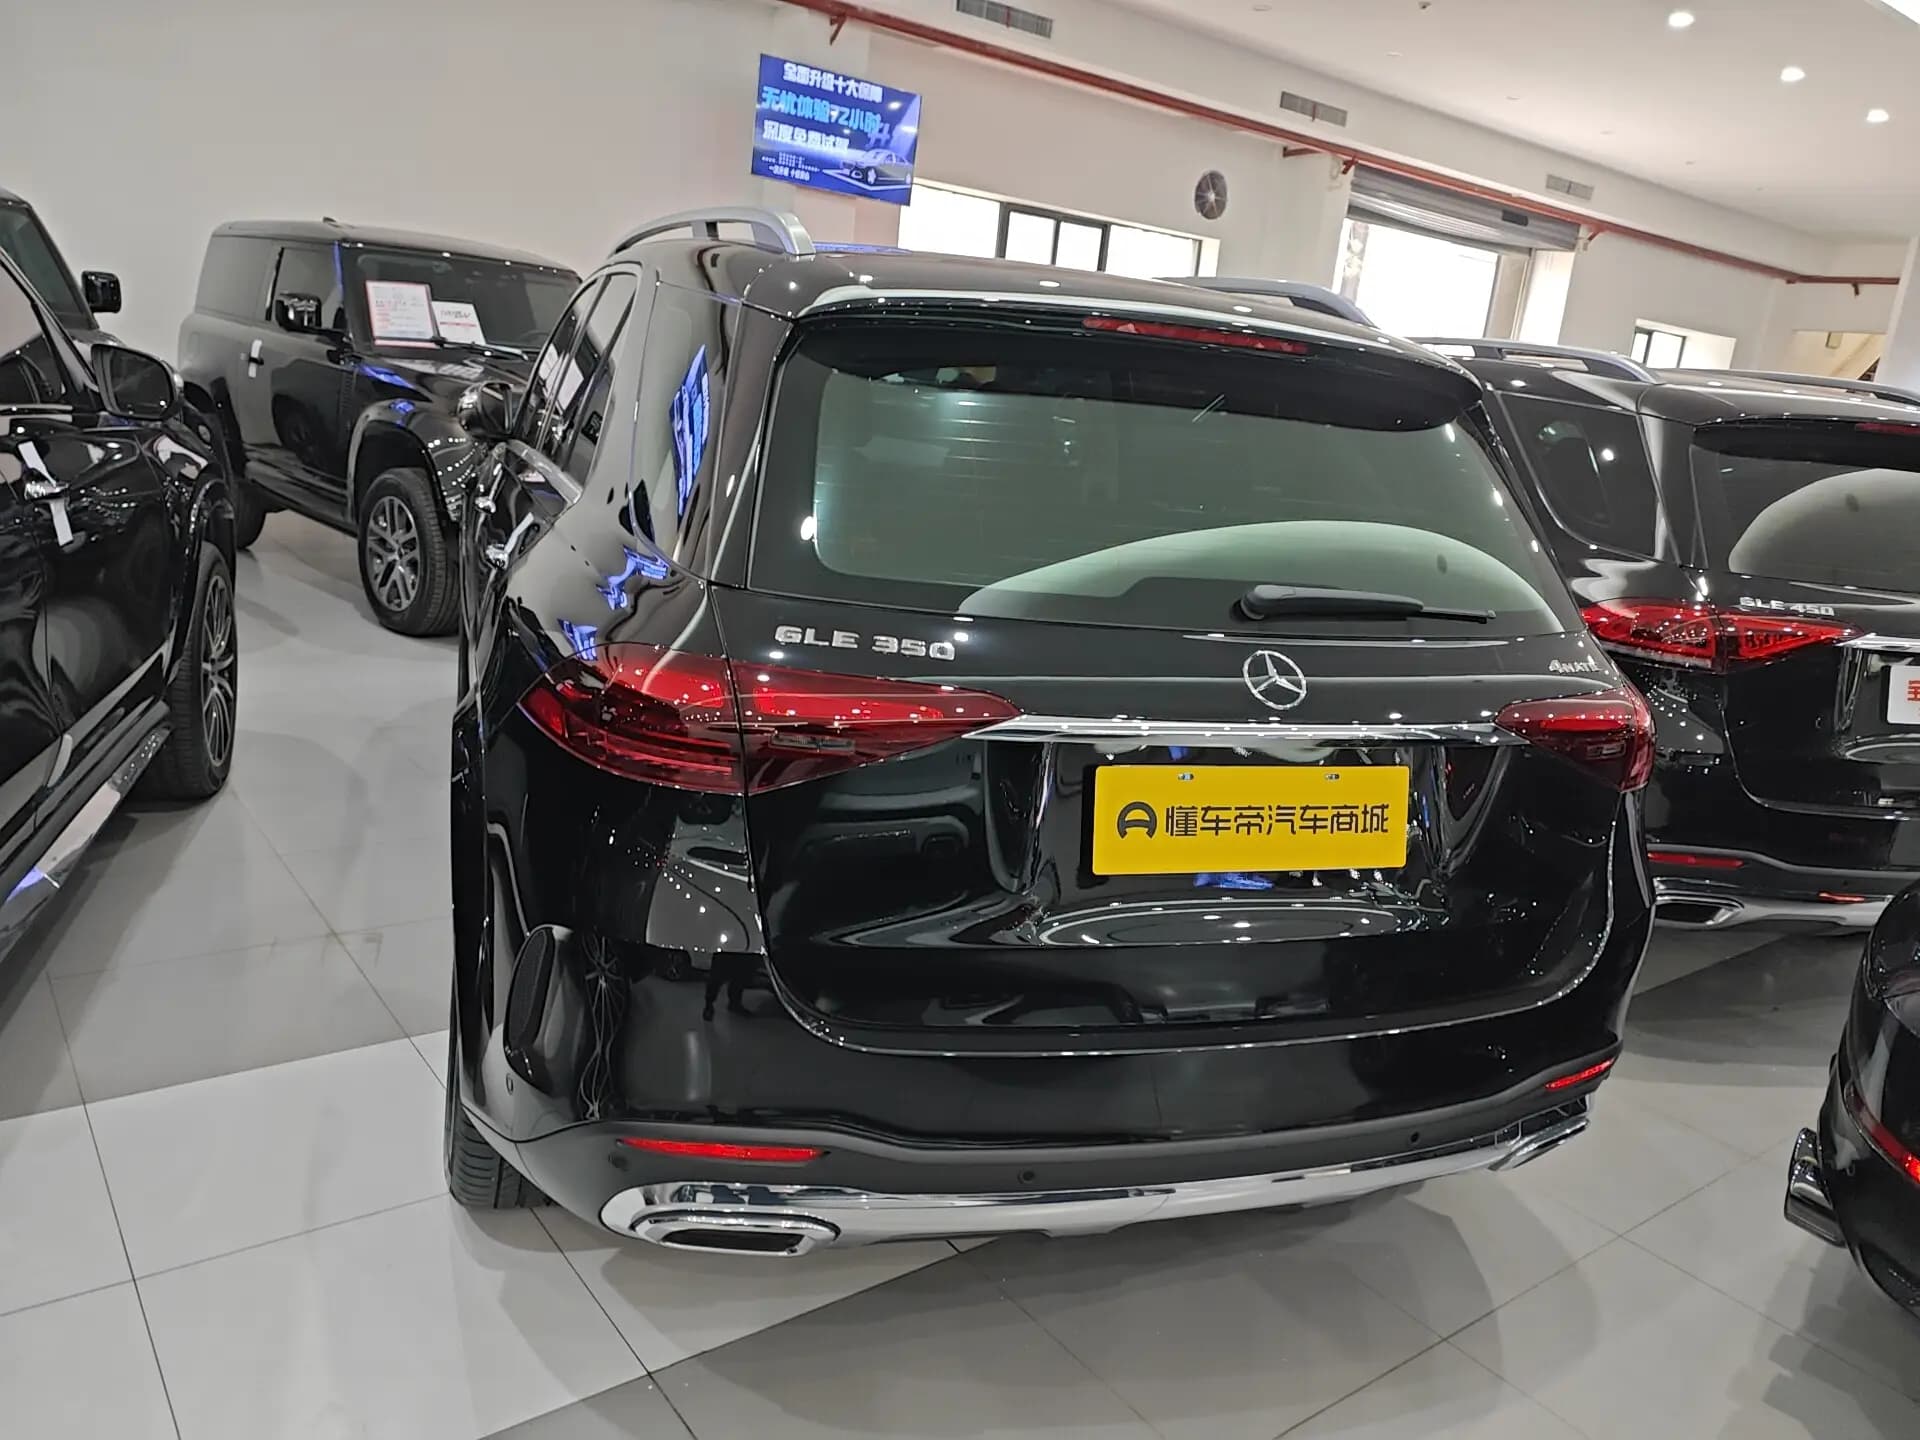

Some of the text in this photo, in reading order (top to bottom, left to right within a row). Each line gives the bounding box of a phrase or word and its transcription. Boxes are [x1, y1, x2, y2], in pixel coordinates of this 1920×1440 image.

[1739, 596, 1835, 617] GLE 450
[774, 624, 956, 661] GLE 350
[1164, 802, 1390, 837] 懂车帝汽车商城
